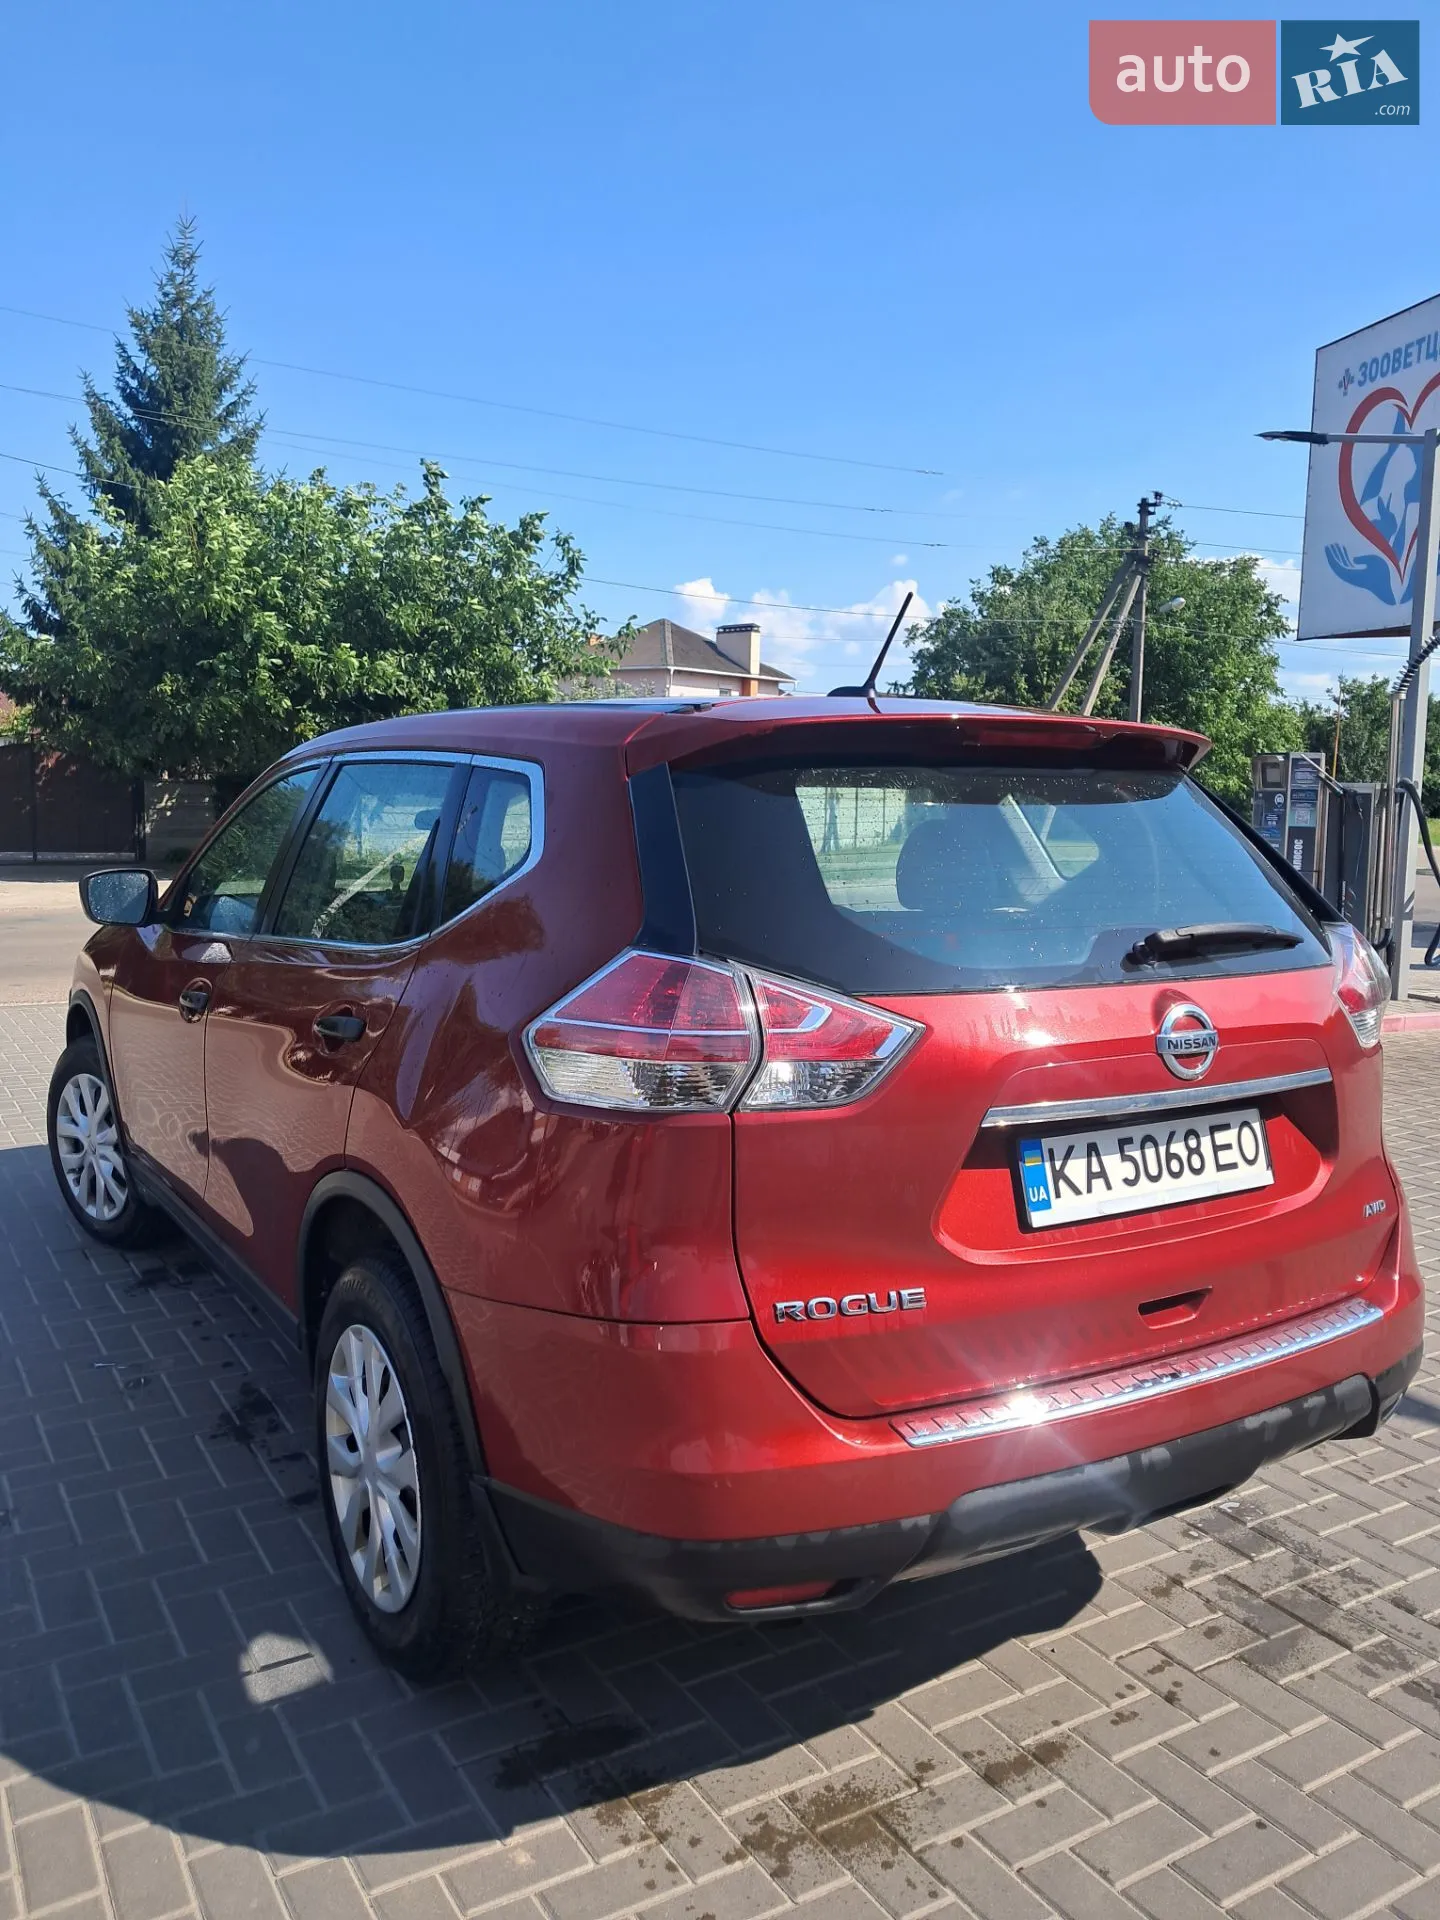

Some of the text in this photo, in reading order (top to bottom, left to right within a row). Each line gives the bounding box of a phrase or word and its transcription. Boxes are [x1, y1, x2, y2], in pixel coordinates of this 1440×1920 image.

[1358, 330, 1440, 387] ЗООВЕТЦ
[1167, 1035, 1216, 1050] NISSAN
[1047, 1120, 1260, 1199] KA 5068 EO
[1028, 1186, 1048, 1203] UA
[1363, 1199, 1386, 1218] AWD
[775, 1287, 927, 1323] ROGUE
